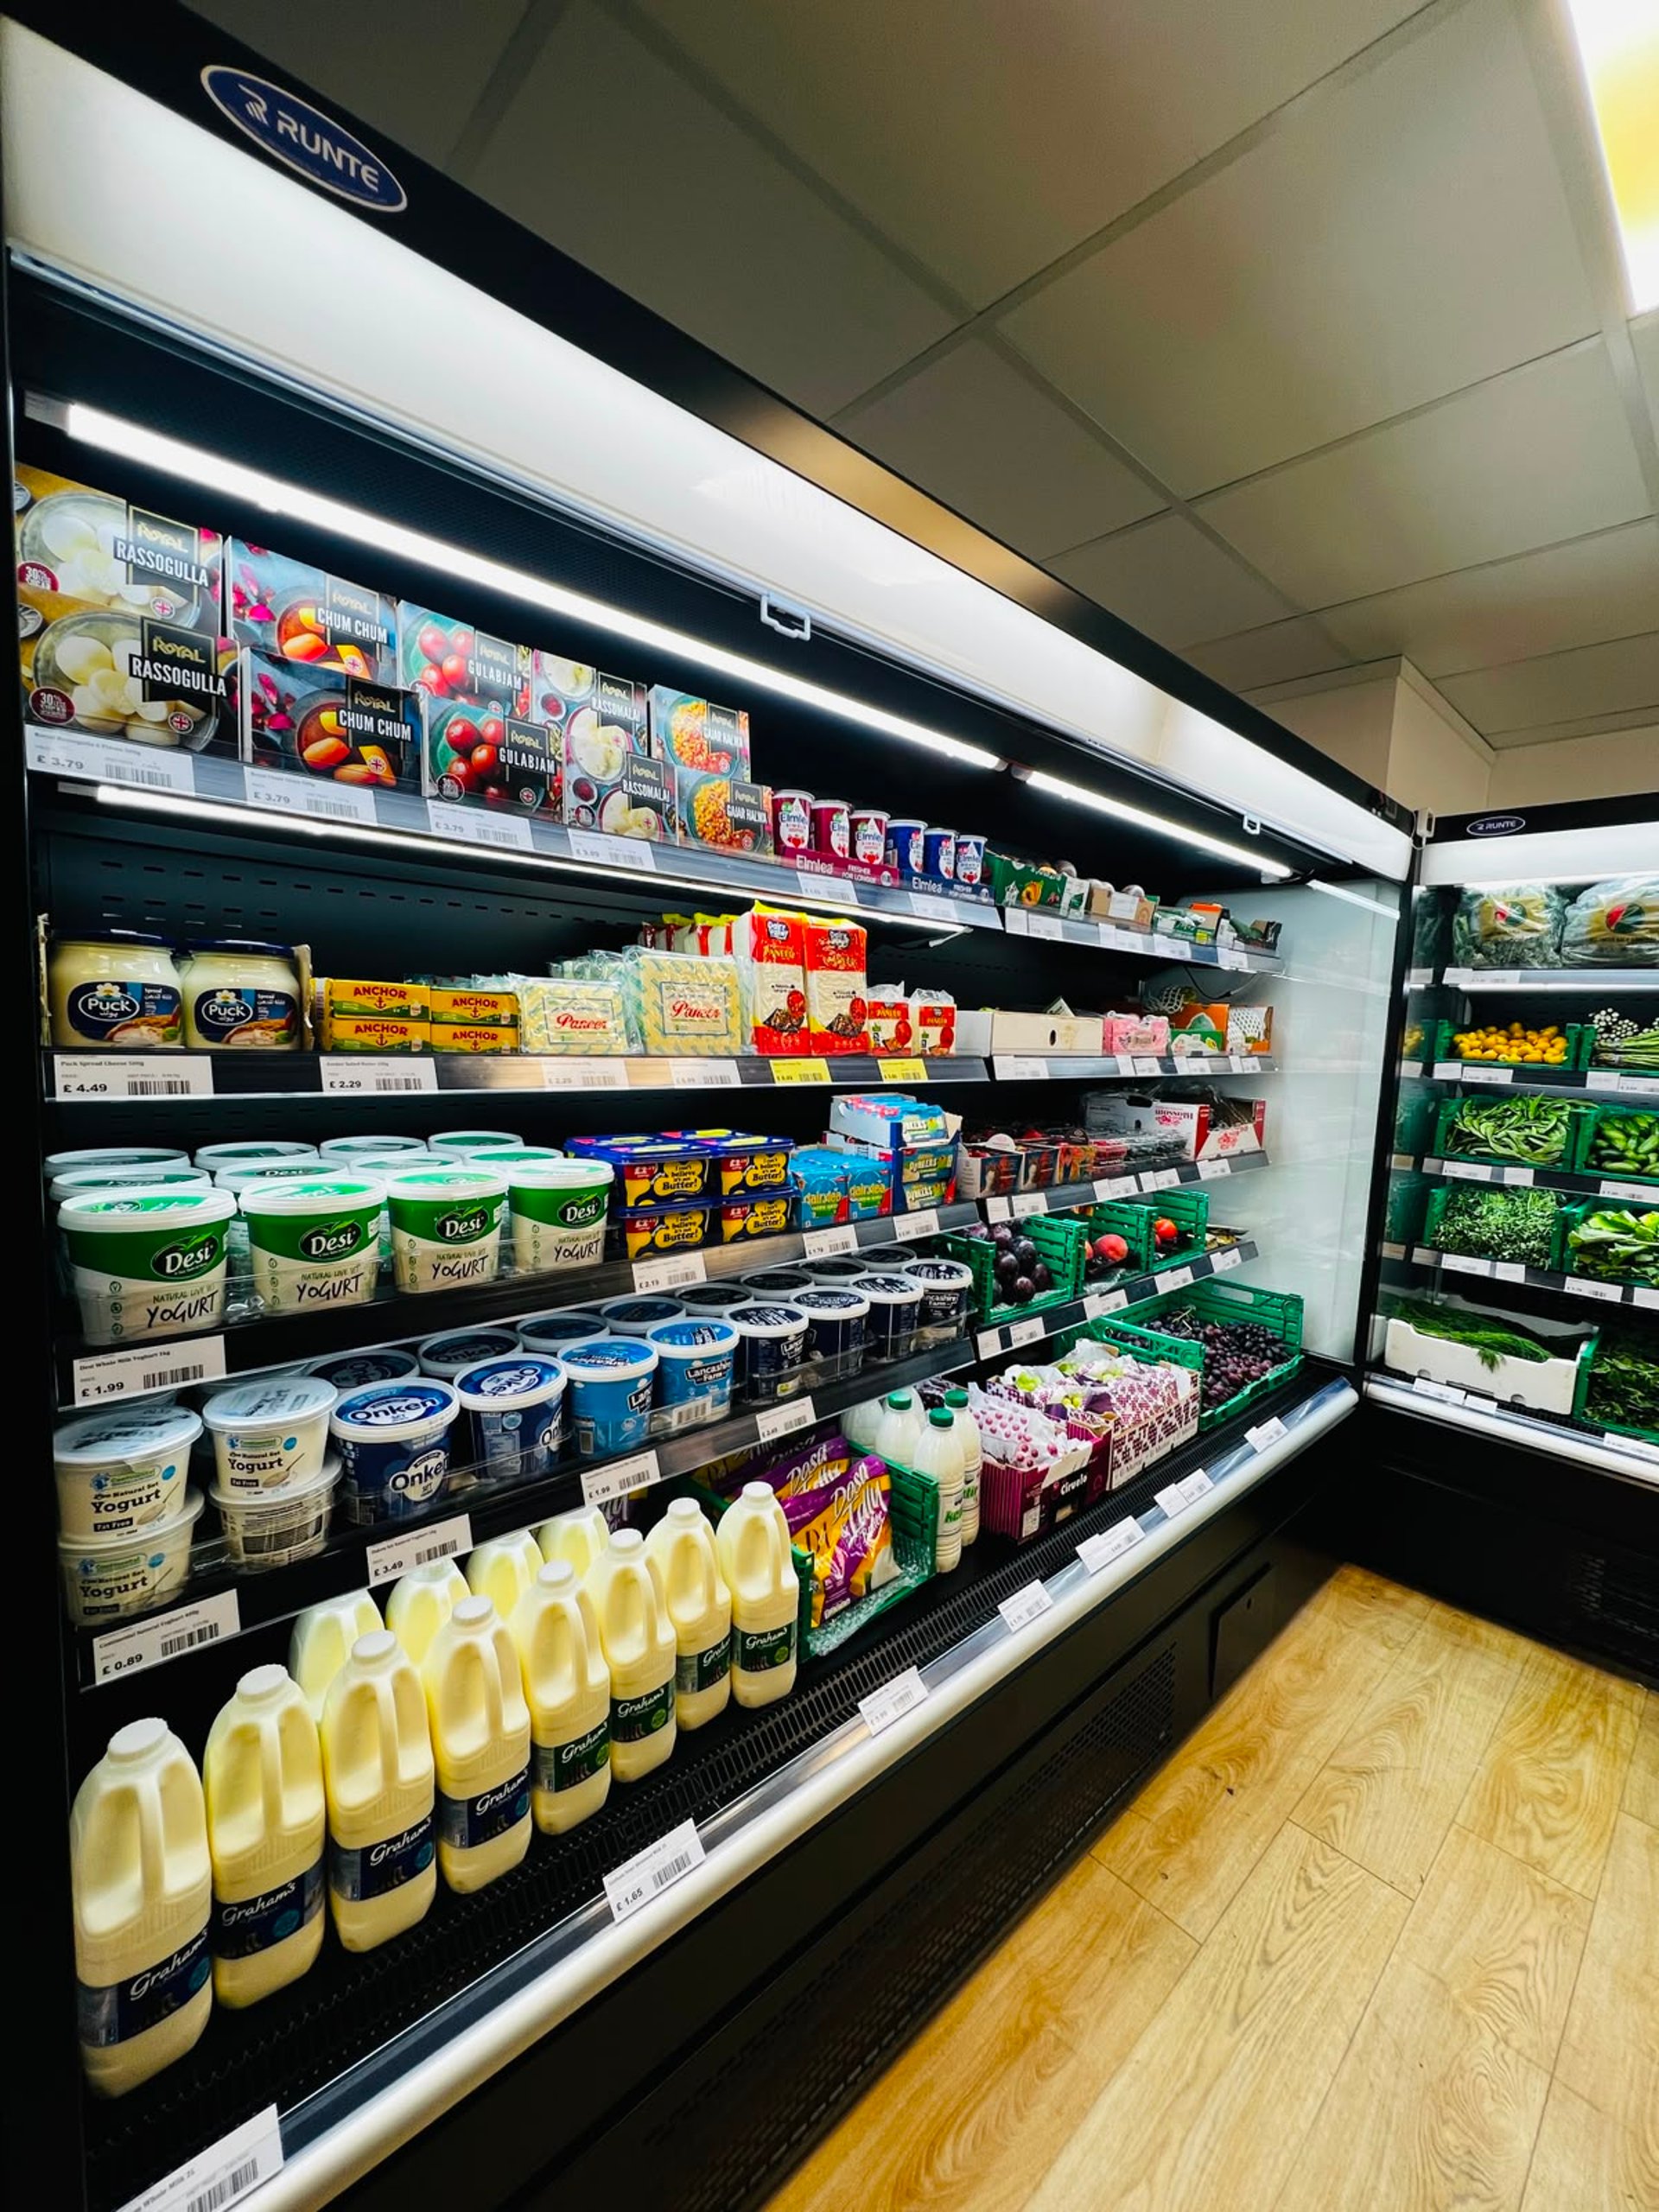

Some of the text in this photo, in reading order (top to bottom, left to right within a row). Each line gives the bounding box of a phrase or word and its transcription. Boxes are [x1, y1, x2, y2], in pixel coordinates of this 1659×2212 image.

[277, 110, 379, 193] RUNTE
[117, 543, 209, 587] RASSOGULLA
[317, 608, 387, 644] CHUM CHUM
[153, 634, 206, 663] ROYAL
[131, 656, 227, 696] RASSOGULLA
[339, 709, 412, 741] CHUM CHUM
[52, 756, 84, 770] 3.79
[499, 747, 556, 774] GULABJAM
[264, 793, 290, 804] 3.79
[622, 779, 671, 803] RASSOMALAI
[1485, 820, 1516, 830] RUNTE
[796, 854, 835, 874] Elmlea
[912, 876, 943, 893] Elmlea
[353, 986, 407, 1000] ANCHOR
[87, 998, 131, 1012] Puck
[209, 1004, 246, 1017] Puck
[452, 997, 499, 1009] ANCHOR
[354, 1023, 409, 1036] ANCHOR
[453, 1030, 499, 1041] ANCHOR
[76, 1084, 108, 1093] 4.49
[339, 1080, 361, 1089] 2.29
[663, 1179, 697, 1190] Butter!
[566, 1199, 596, 1222] Desi
[445, 1213, 481, 1237] Desi
[311, 1227, 353, 1255] Desi
[166, 1241, 211, 1274] Desi
[153, 1291, 188, 1304] NATURAL
[81, 1382, 124, 1397] £ 1.99
[350, 1398, 436, 1421] Onken
[228, 1458, 283, 1474] Yogurt
[1060, 1473, 1088, 1496] Ciruelo
[91, 1489, 161, 1513] Yogurt
[383, 1560, 404, 1573] 3.49
[79, 1576, 148, 1599] Yogurt
[103, 1655, 143, 1675] £ 0.89
[625, 1887, 644, 1905] 1.65
